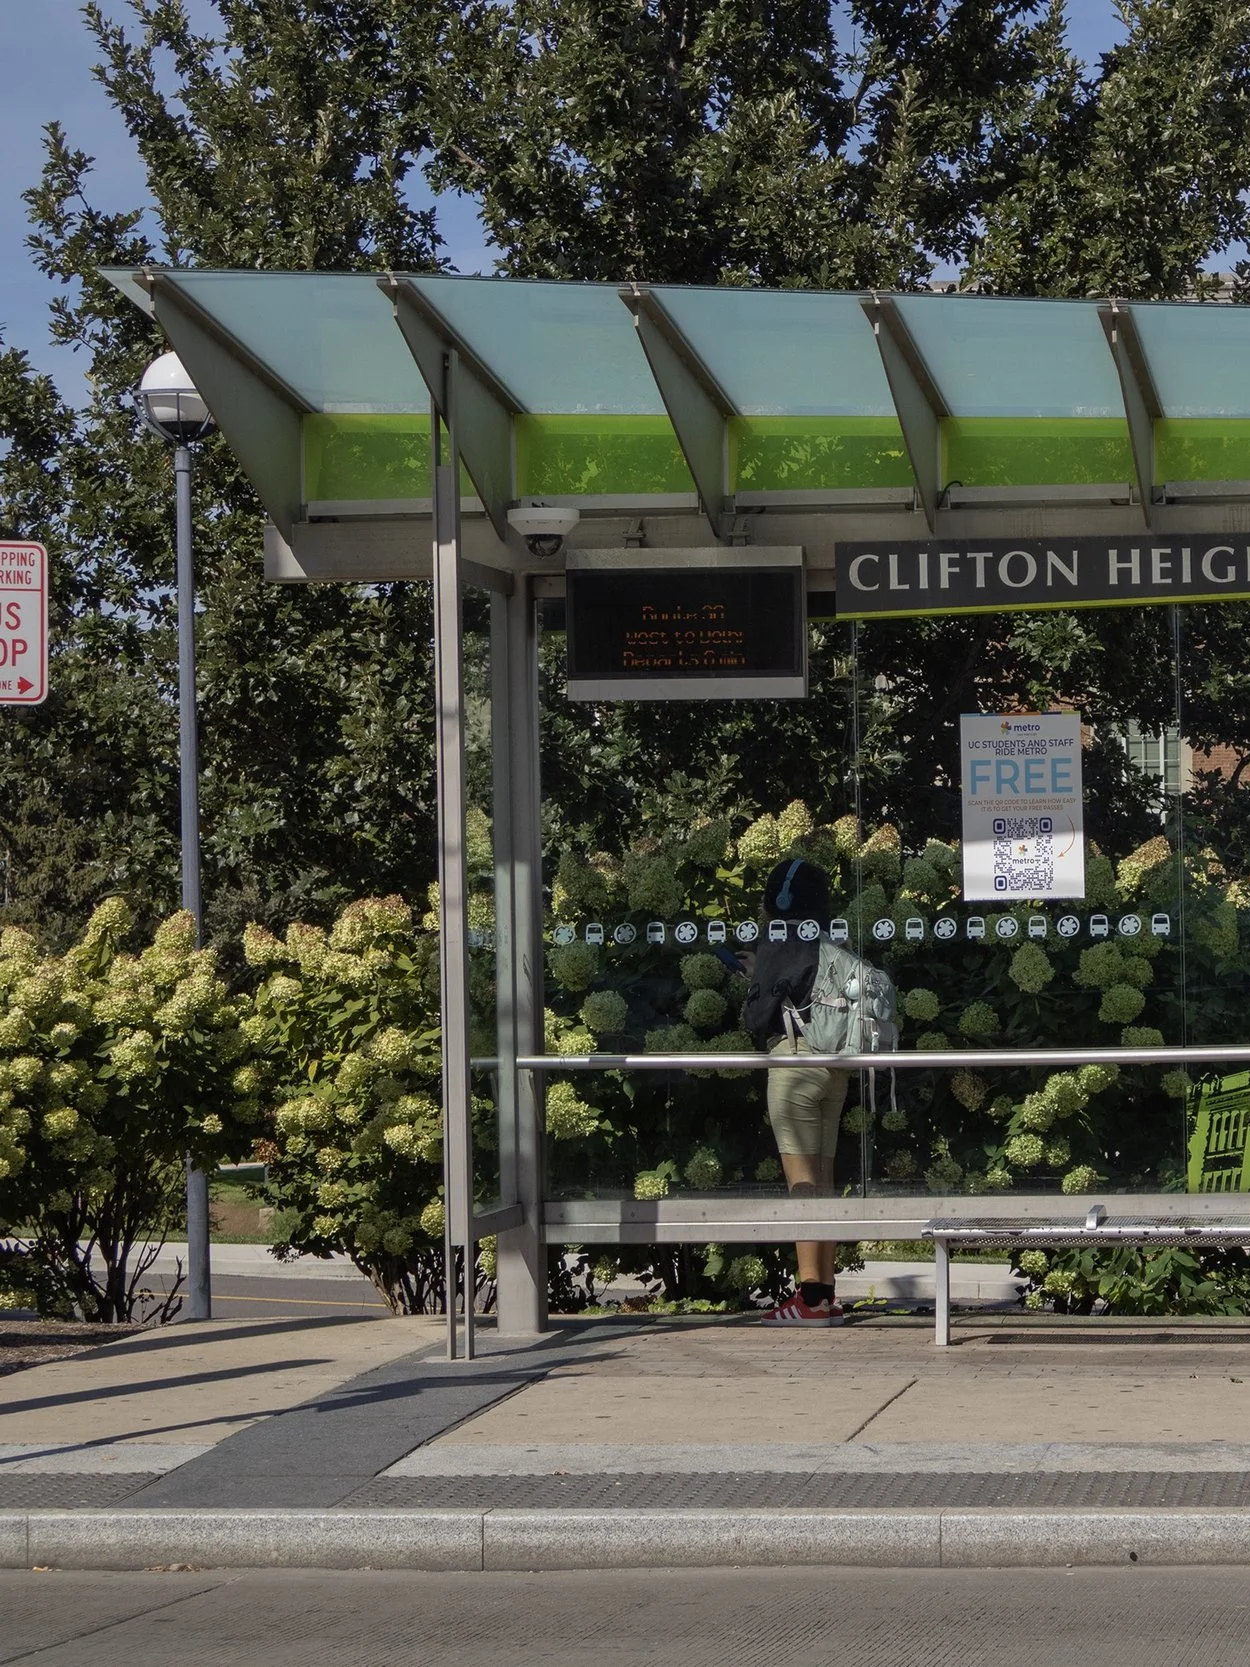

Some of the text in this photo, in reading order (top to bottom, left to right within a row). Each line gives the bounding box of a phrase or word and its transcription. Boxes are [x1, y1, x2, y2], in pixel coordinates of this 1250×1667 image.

[849, 550, 1079, 591] CLIFTON
[0, 602, 21, 631] S
[1014, 724, 1040, 732] metro
[968, 738, 1074, 749] UC STUDENTS AND STAFF
[996, 748, 1048, 756] RIDE METRO
[970, 758, 1073, 795] FREE
